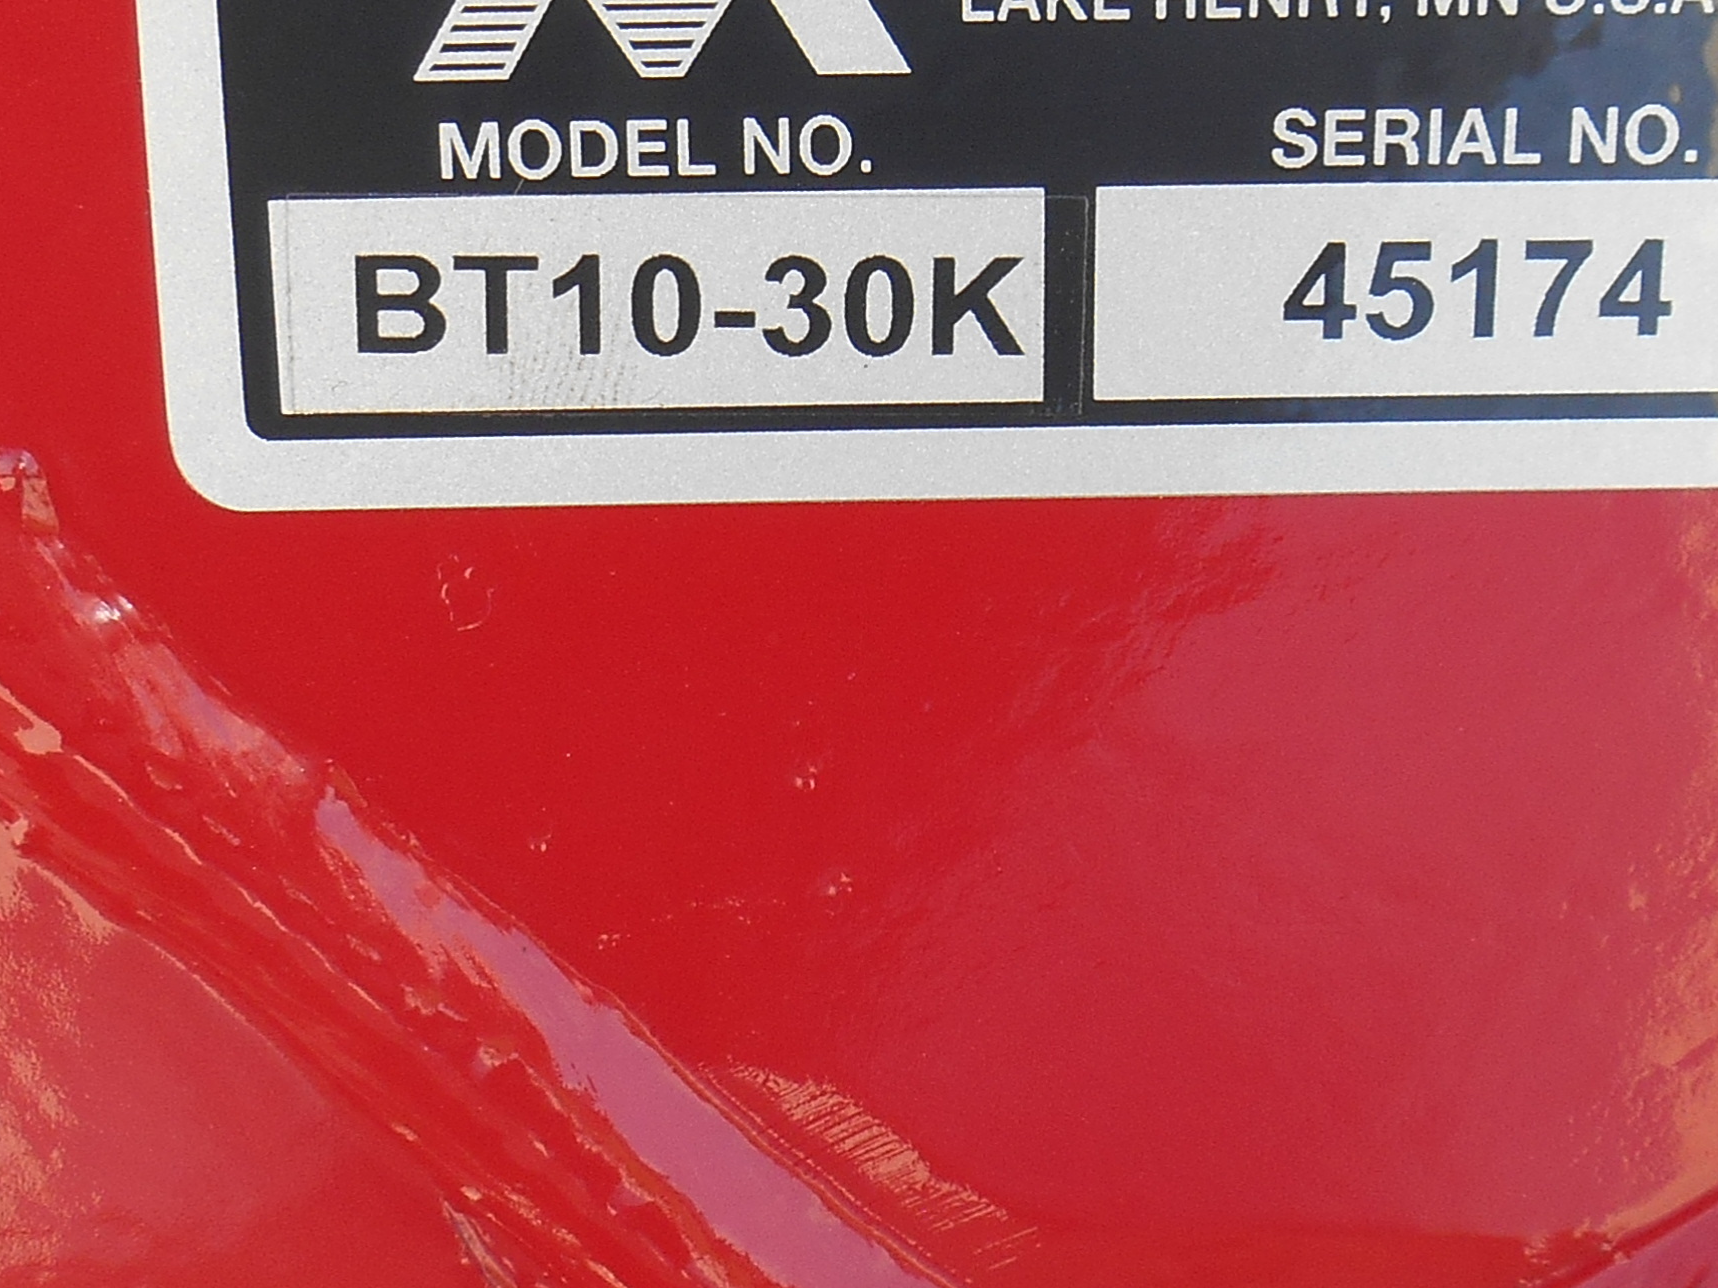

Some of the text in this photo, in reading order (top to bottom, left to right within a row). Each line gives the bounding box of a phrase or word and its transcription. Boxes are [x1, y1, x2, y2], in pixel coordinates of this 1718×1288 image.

[437, 114, 875, 182] MODEL NO.
[1270, 103, 1700, 170] SERIAL NO.
[353, 252, 1026, 359] BT10-30K
[1282, 237, 1673, 341] 45174
